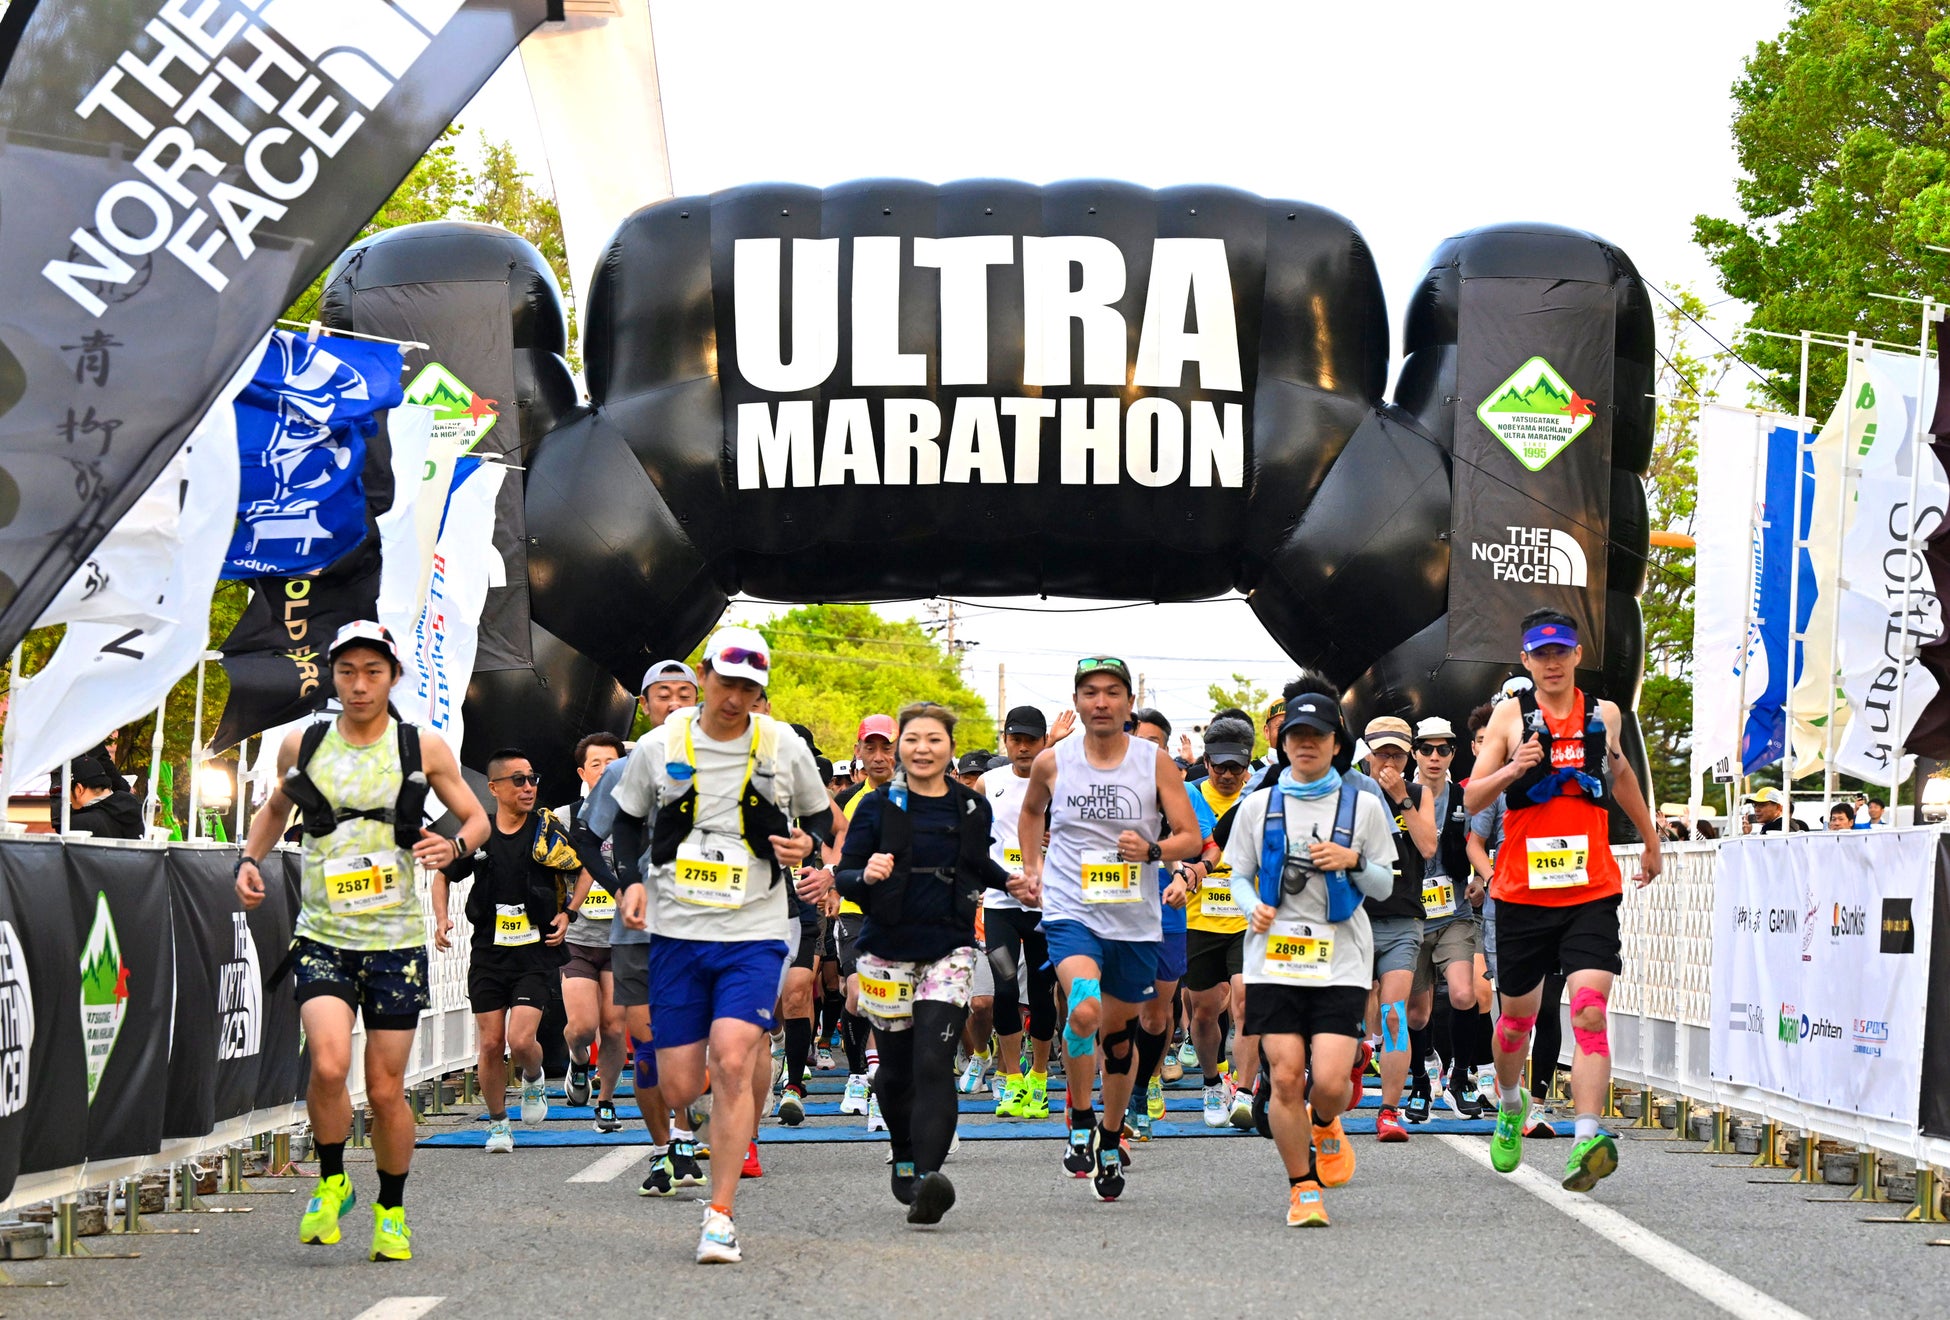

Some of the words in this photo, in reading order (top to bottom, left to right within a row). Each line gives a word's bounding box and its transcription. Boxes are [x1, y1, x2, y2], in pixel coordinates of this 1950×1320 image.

[41, 22, 307, 318] NORTH
[165, 73, 366, 293] FACE
[734, 234, 1243, 392] ULTRA
[1511, 415, 1560, 425] YATSUGATAKE
[1497, 423, 1537, 432] NOBEYAMA
[1538, 425, 1573, 434] HIGHLAND
[737, 396, 1243, 490] MARATHON
[1527, 433, 1566, 442] MARATHON
[1523, 447, 1547, 458] 1995
[1506, 526, 1549, 547] THE
[1471, 542, 1548, 565] NORTH
[1493, 562, 1548, 584] FACE
[1089, 784, 1116, 796] THE
[1067, 795, 1116, 807] NORTH
[1080, 807, 1116, 820] FACE
[1536, 857, 1565, 868] 2164
[1577, 855, 1584, 865] B
[684, 867, 717, 882] 2755
[733, 873, 741, 884] B
[1090, 871, 1120, 882] 2196
[336, 877, 370, 894] 2587
[385, 874, 393, 884] B
[585, 895, 608, 905] 2782
[1207, 892, 1231, 901] 3066
[1419, 893, 1437, 904] 541
[1768, 908, 1798, 934] GARMIN
[1275, 942, 1306, 955] 2898
[1320, 947, 1327, 957] B
[900, 987, 907, 997] B
[1809, 1017, 1843, 1043] phiten
